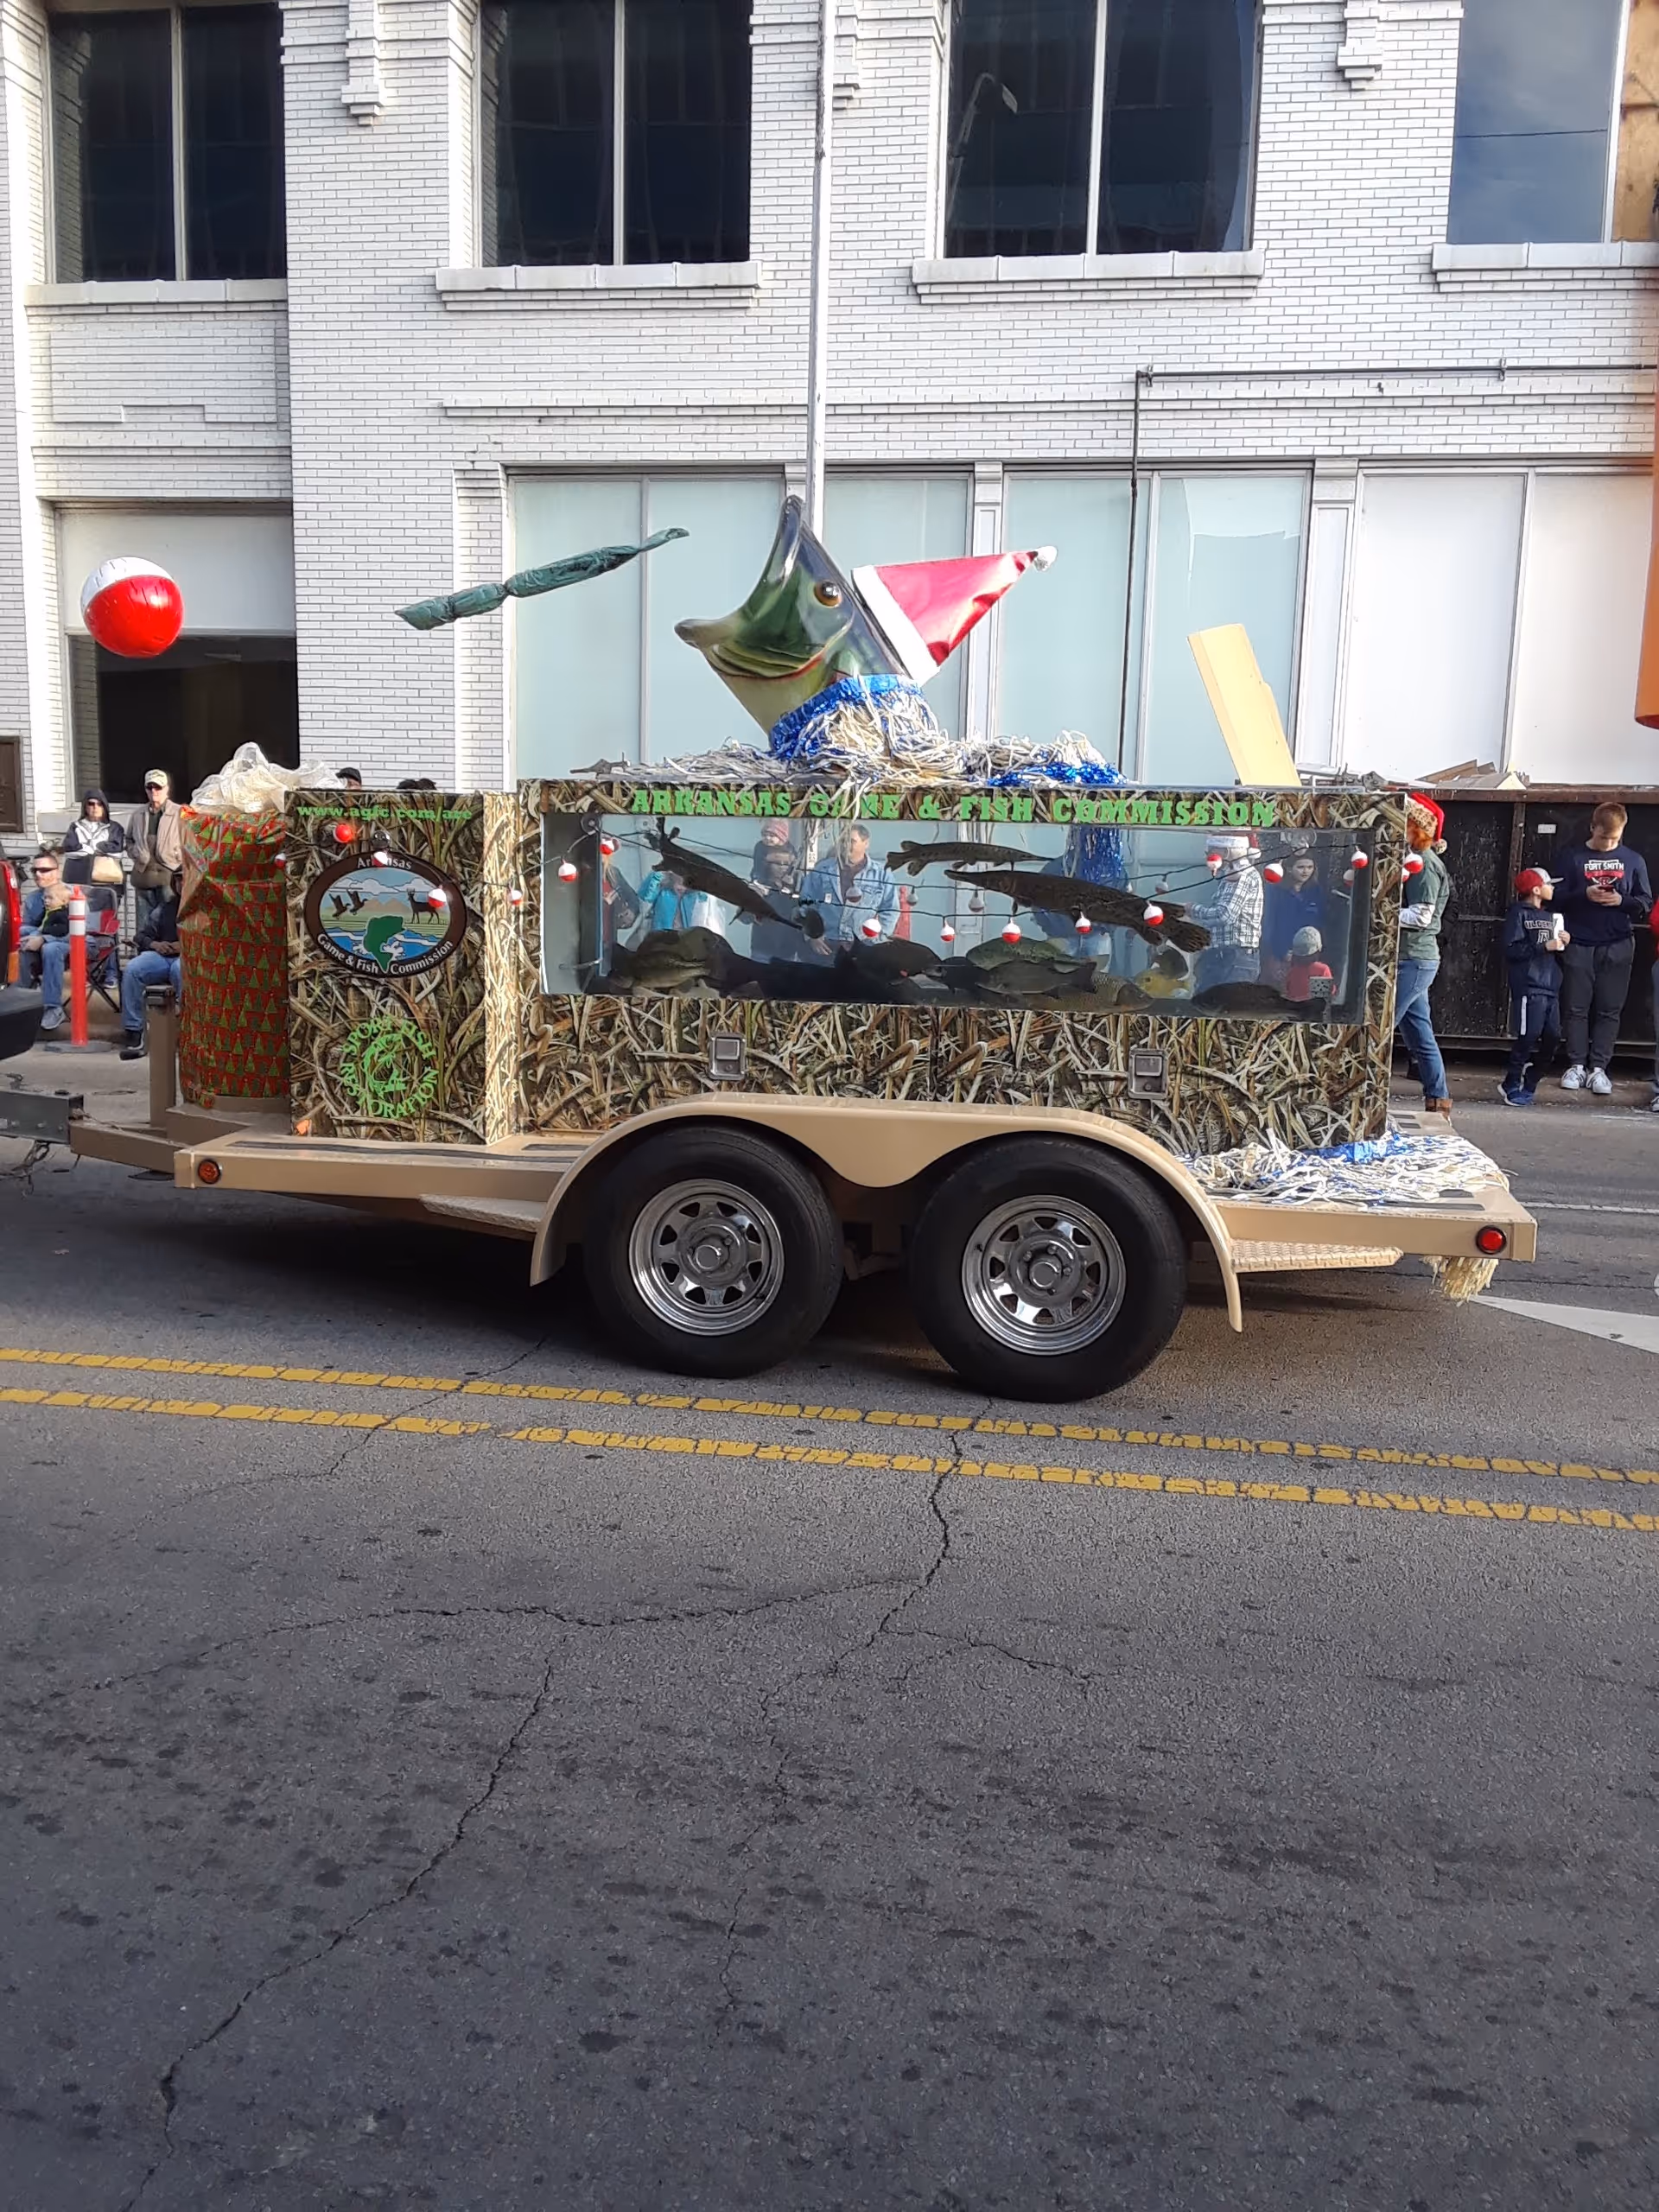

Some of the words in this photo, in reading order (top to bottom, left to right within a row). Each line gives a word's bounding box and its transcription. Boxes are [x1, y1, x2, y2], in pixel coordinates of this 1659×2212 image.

[632, 790, 791, 816] ARKANSAS
[809, 793, 900, 819] GAME
[918, 795, 940, 819] &
[959, 796, 1033, 823] FISH
[1053, 798, 1278, 827] COMMISSION
[357, 855, 412, 870] Arnsas
[1585, 863, 1603, 872] FORT
[1603, 862, 1624, 871] SMITH
[317, 933, 346, 961] Game
[346, 955, 355, 966] &
[356, 959, 379, 974] Fish
[391, 940, 454, 975] Commission
